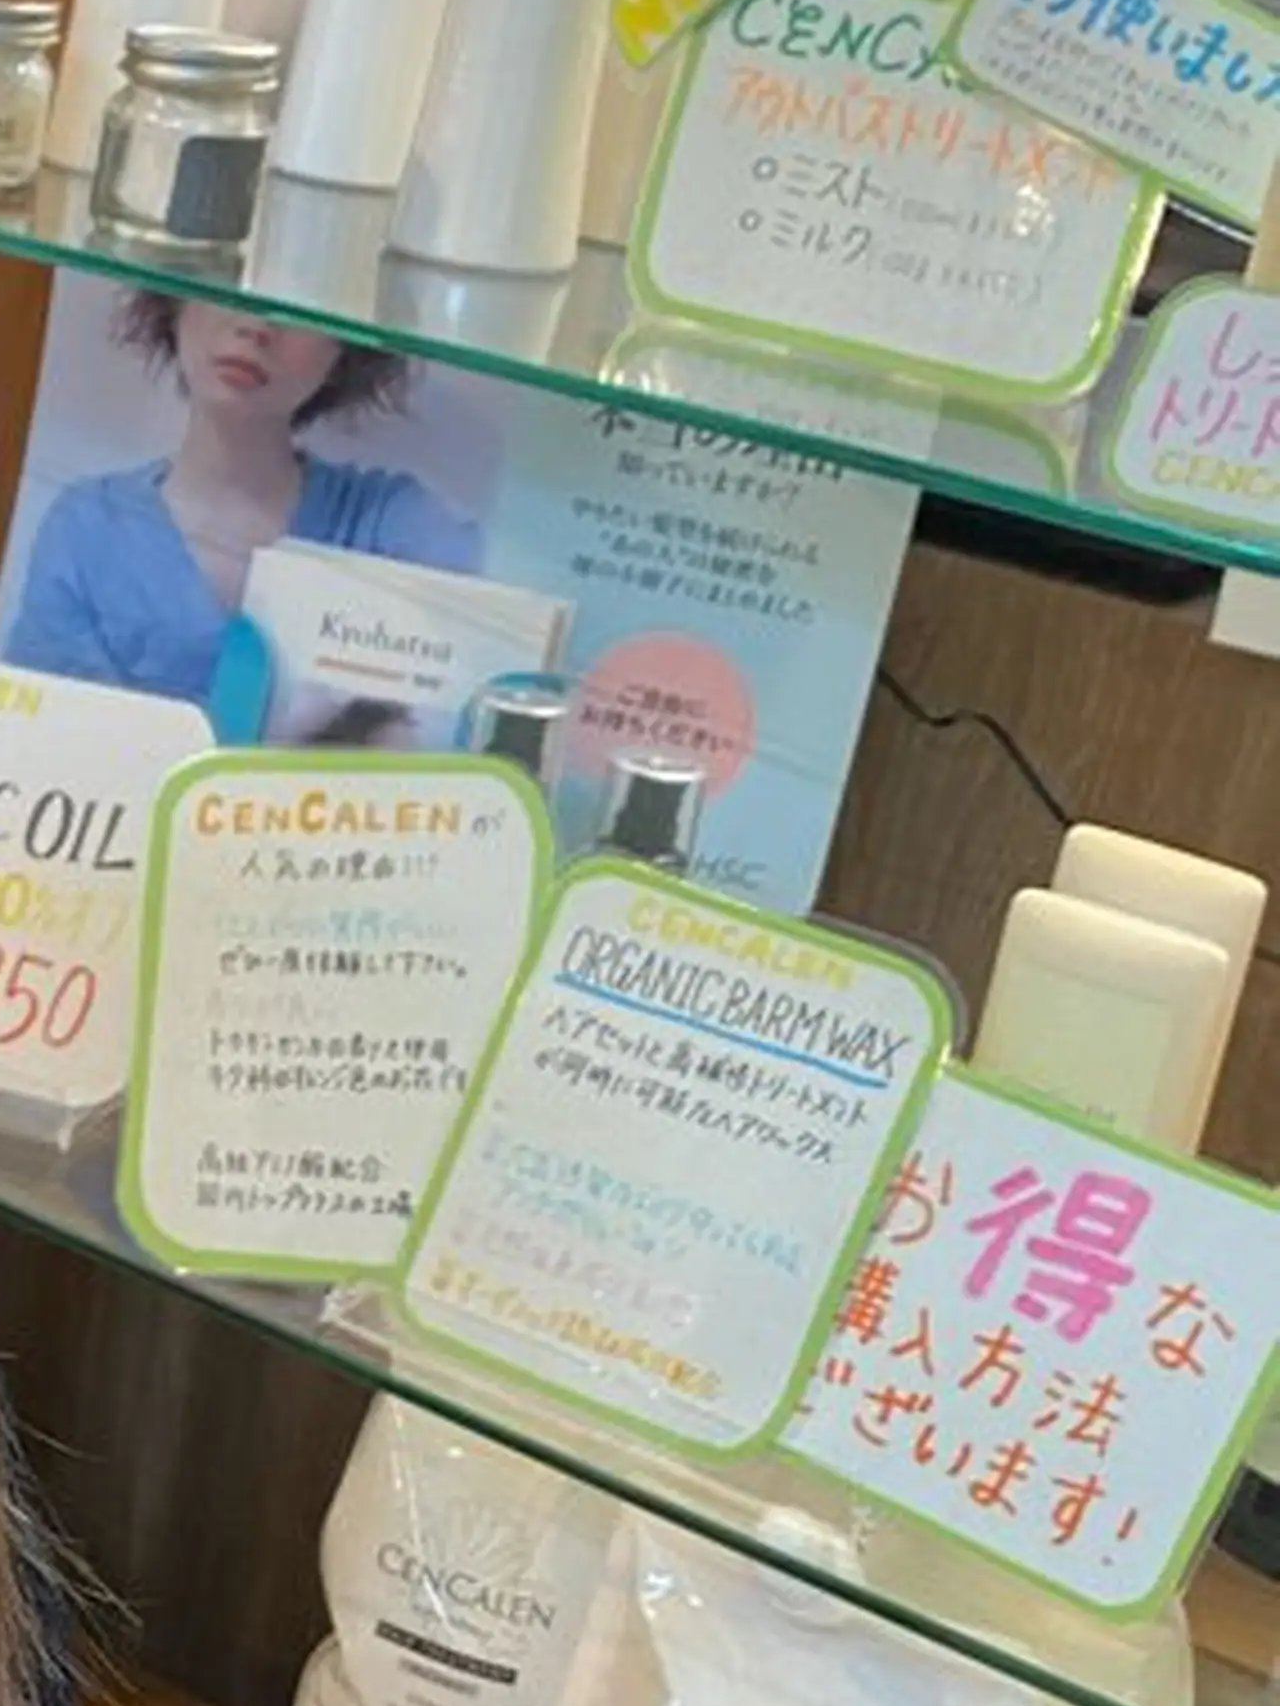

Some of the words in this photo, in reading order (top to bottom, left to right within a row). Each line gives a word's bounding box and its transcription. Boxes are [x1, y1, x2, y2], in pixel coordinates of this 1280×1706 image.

[23, 786, 137, 872] OIL
[196, 788, 463, 836] CENCALEN
[559, 925, 726, 1017] ORGANIC
[719, 976, 828, 1046] BARM
[827, 1011, 913, 1081] WAX
[875, 1150, 1240, 1379] お得な
[376, 1541, 557, 1631] CENCALEN
